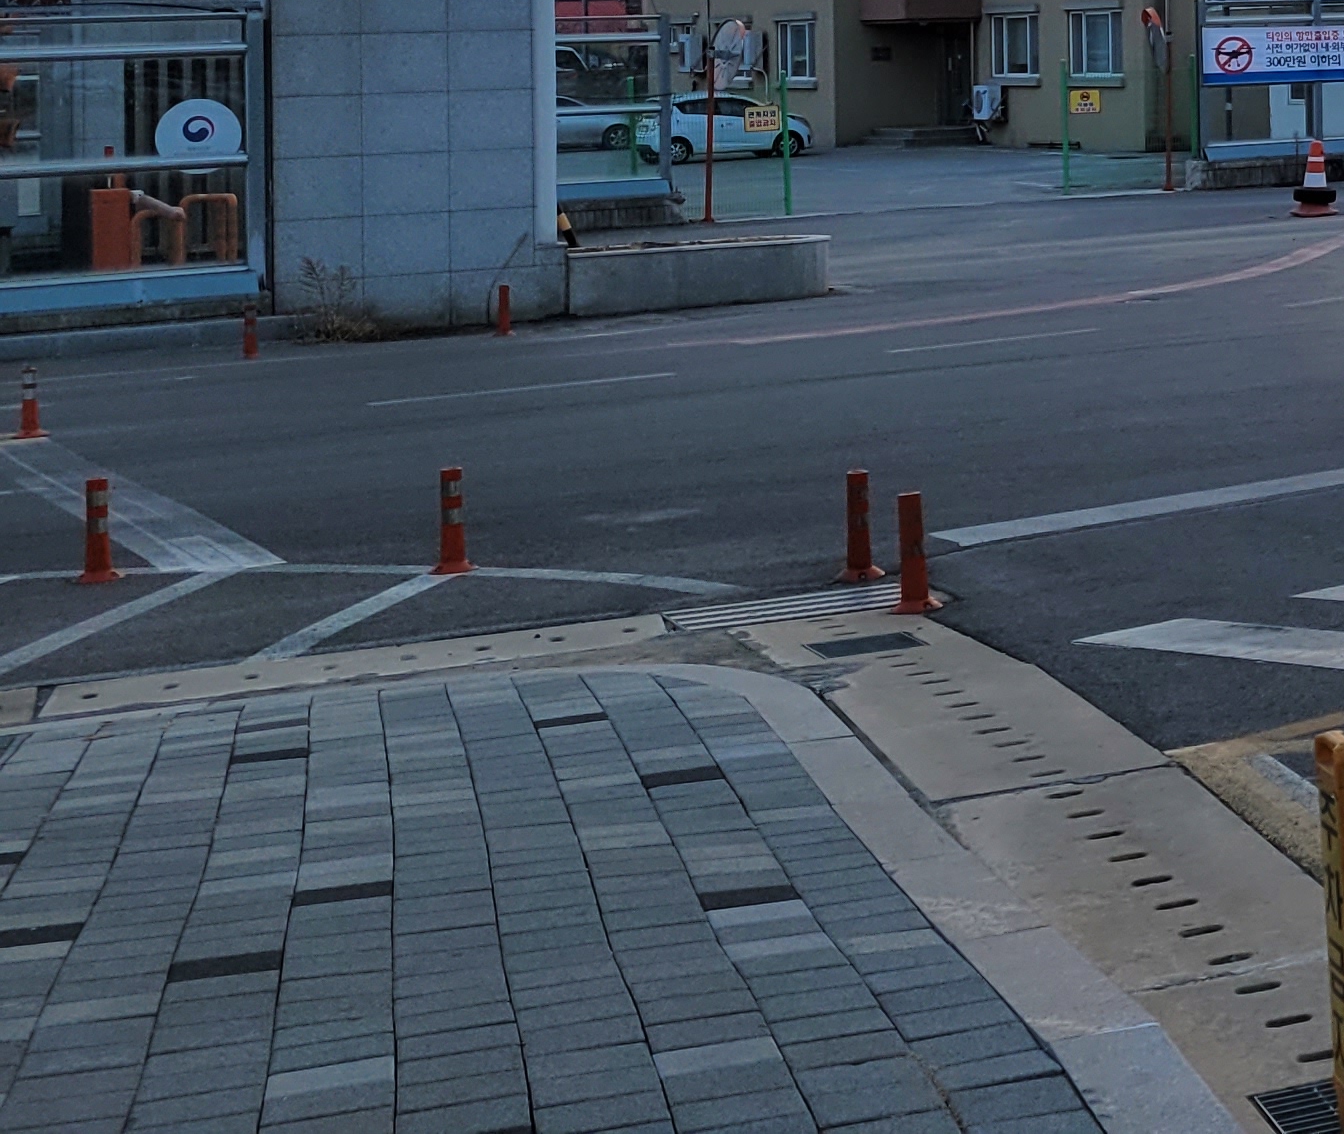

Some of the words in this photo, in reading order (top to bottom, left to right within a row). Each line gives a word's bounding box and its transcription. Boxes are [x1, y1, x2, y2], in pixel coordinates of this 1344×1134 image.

[1295, 30, 1340, 42] 항만출입증
[1266, 42, 1283, 53] 사전
[1285, 41, 1319, 53] 허가없이
[1266, 53, 1307, 68] 300만원
[1310, 53, 1341, 67] 이하의
